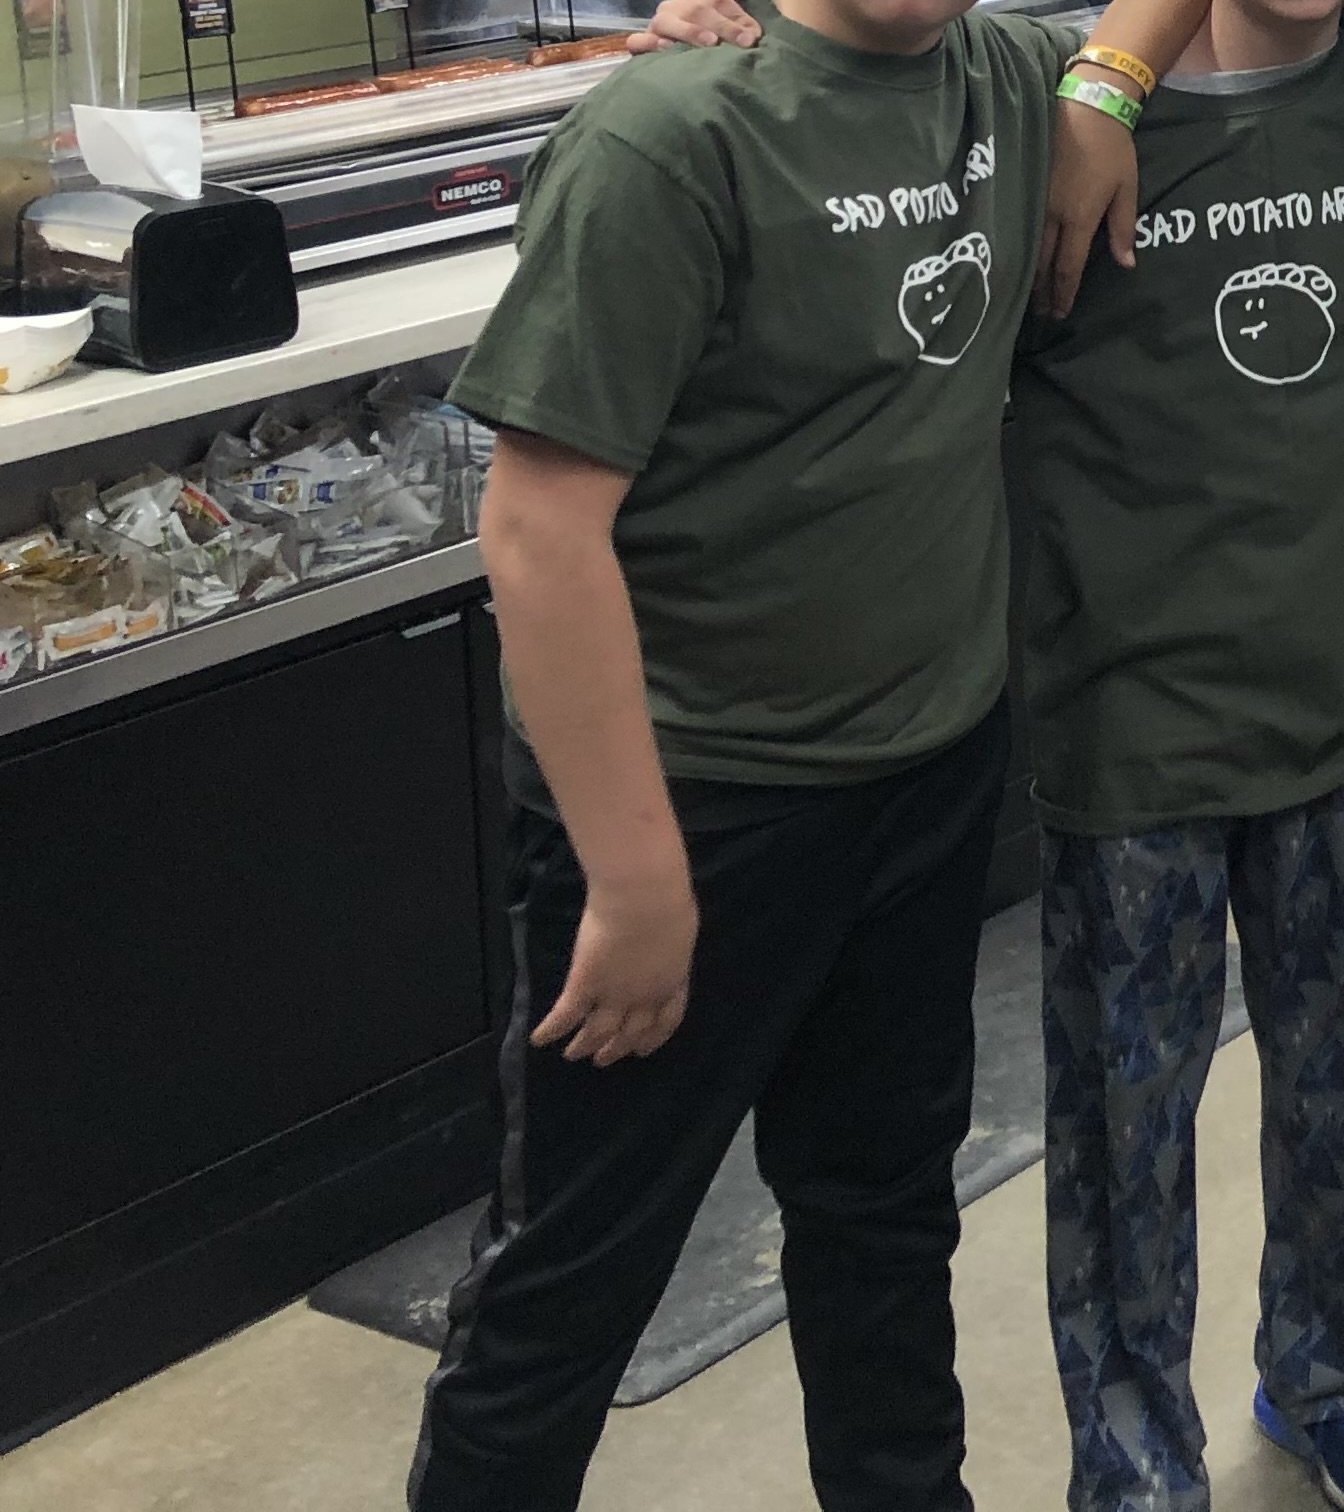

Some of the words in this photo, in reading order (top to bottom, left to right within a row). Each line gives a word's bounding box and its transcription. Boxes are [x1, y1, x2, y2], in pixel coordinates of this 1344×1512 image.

[441, 179, 502, 202] NEMCO
[825, 194, 885, 233] SAD
[1136, 207, 1195, 249] SAD
[1208, 192, 1312, 241] POTATO
